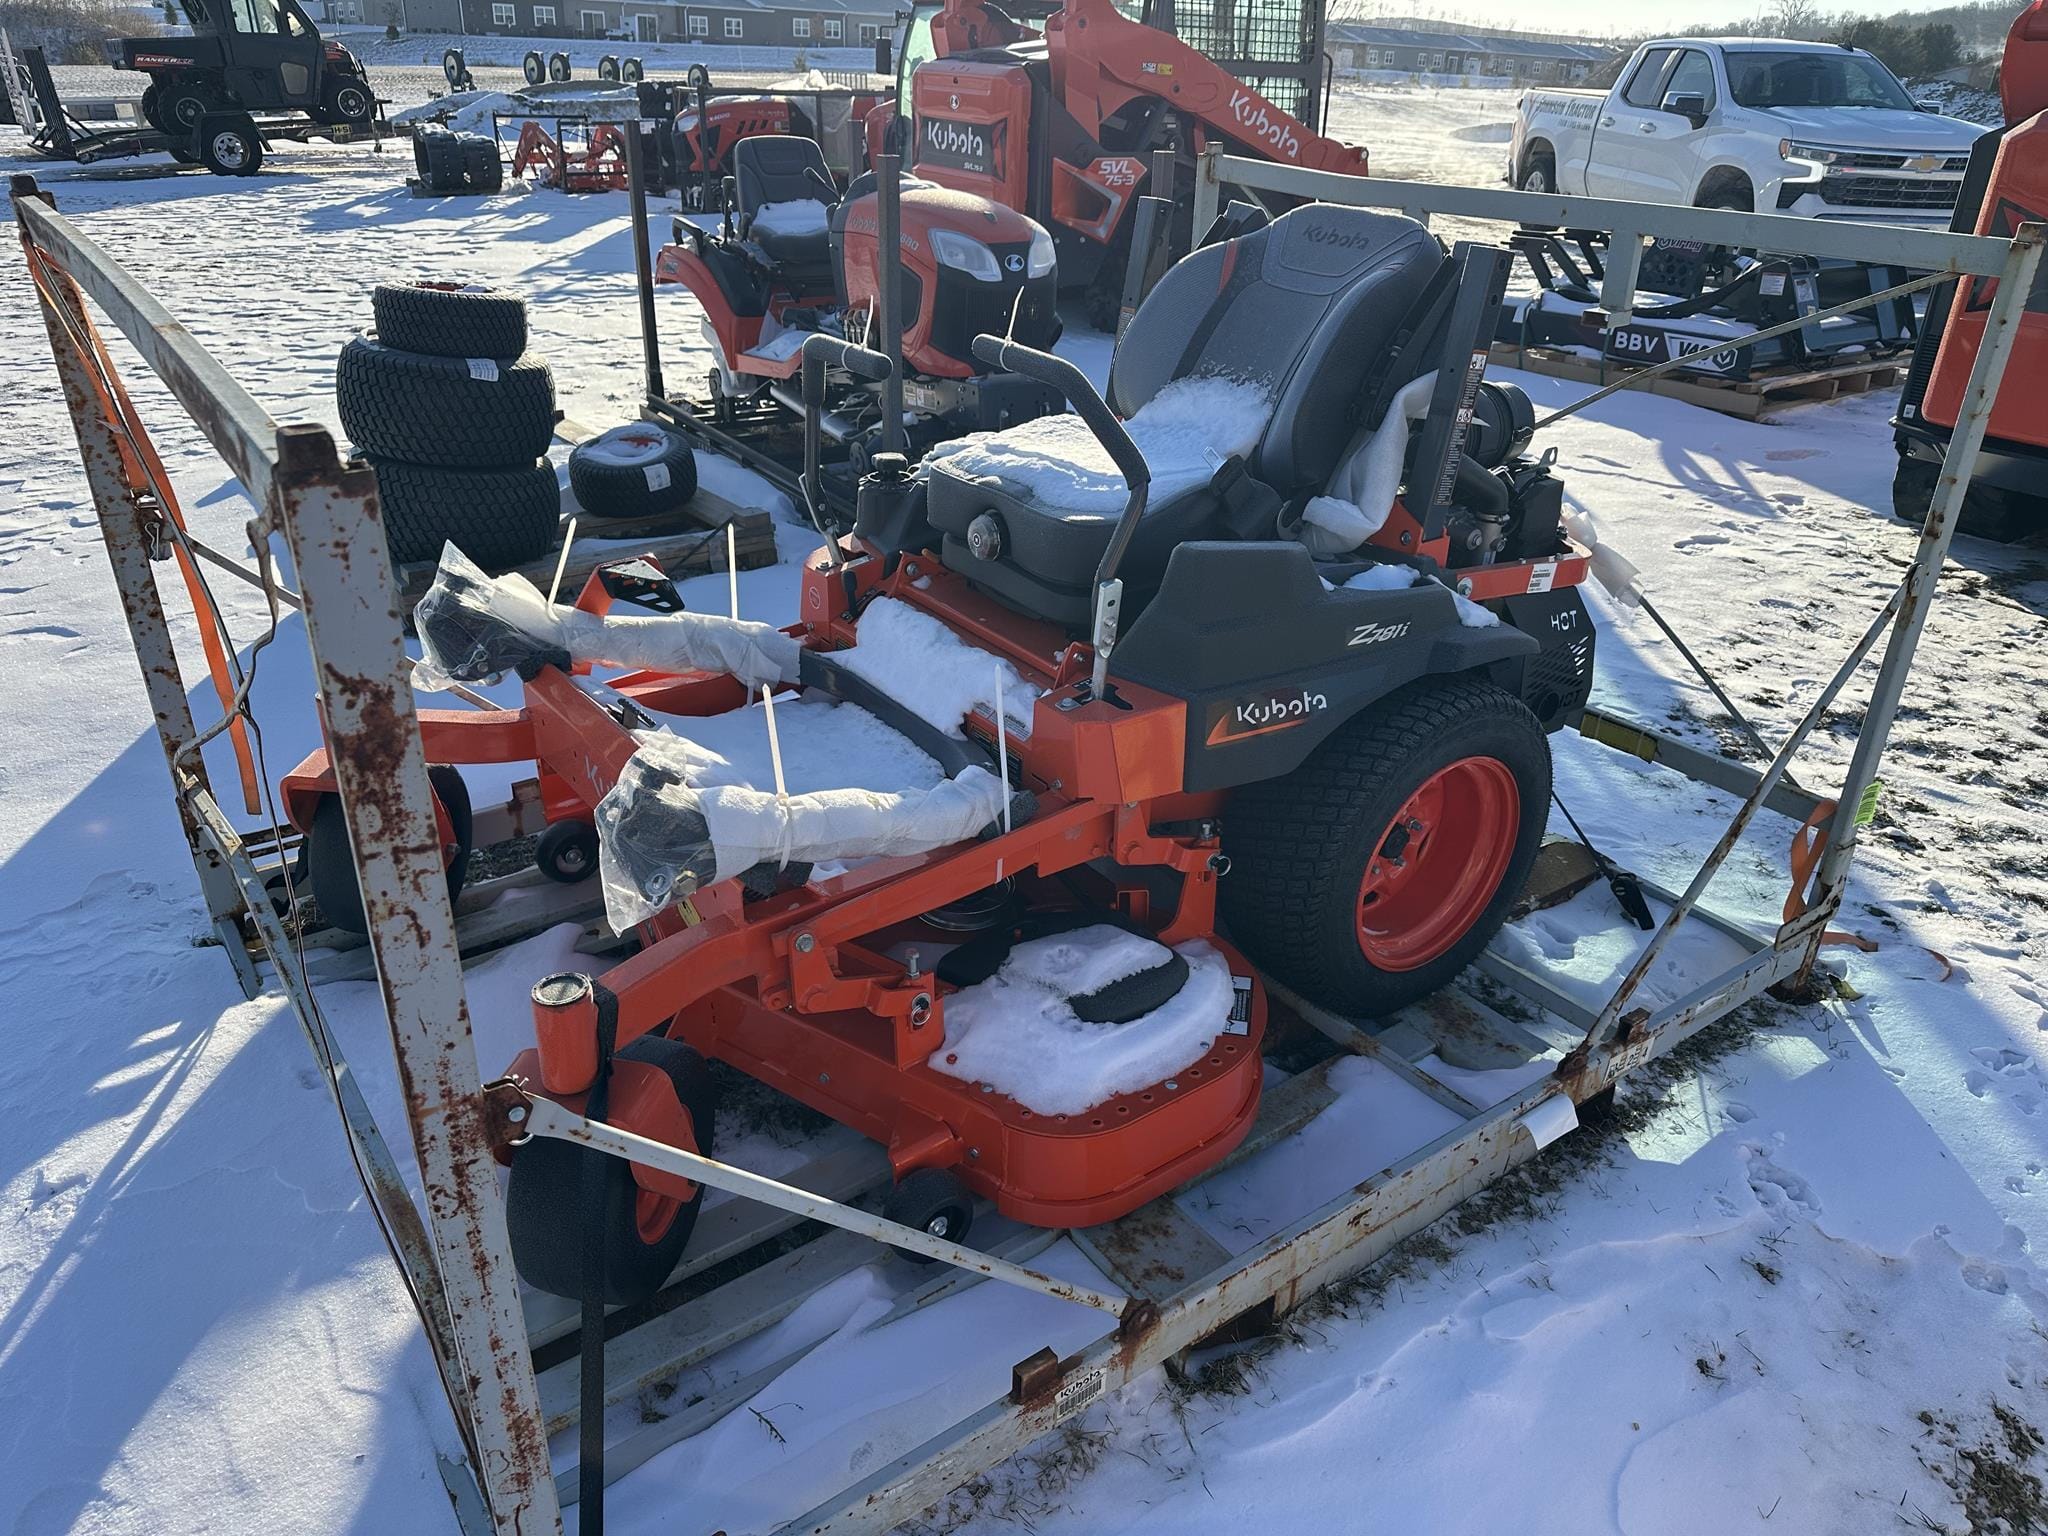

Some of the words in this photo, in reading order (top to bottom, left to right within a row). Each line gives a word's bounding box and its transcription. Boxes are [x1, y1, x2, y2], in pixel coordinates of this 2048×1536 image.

[1228, 89, 1300, 159] Kubota
[927, 121, 983, 156] Kubota
[1098, 160, 1133, 174] SVL
[1104, 174, 1135, 186] 75-3
[1302, 224, 1370, 250] Kubota
[1614, 331, 1659, 354] BBV
[1550, 610, 1577, 631] HOT
[1347, 621, 1412, 646] Z781i
[1236, 691, 1328, 725] Kubota
[1060, 1370, 1100, 1398] Kubota
